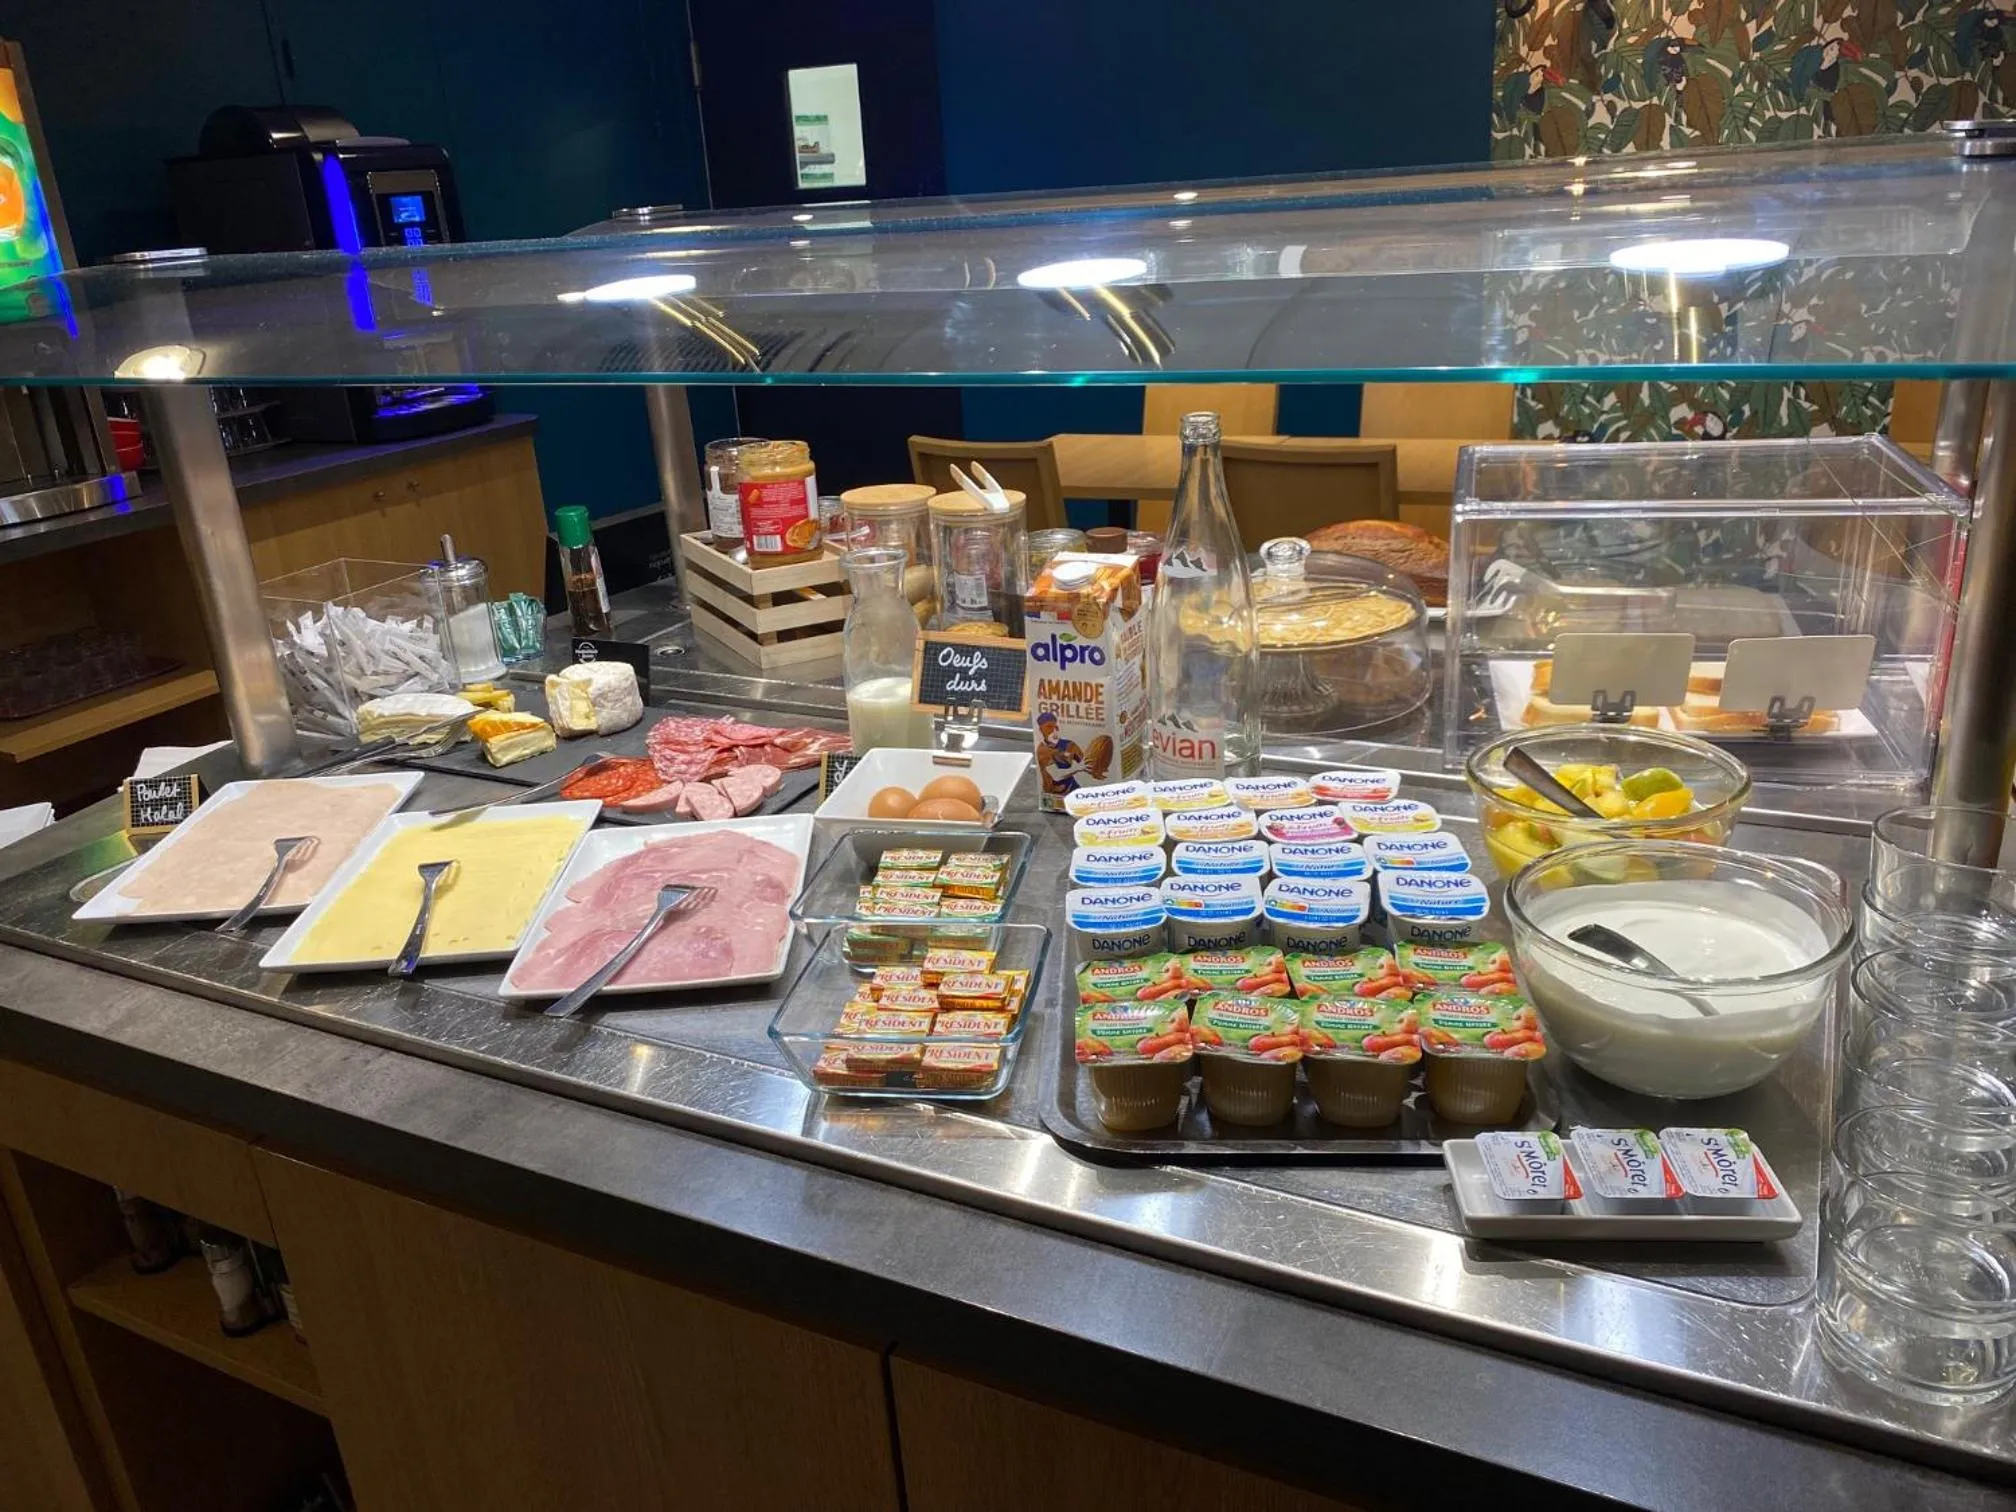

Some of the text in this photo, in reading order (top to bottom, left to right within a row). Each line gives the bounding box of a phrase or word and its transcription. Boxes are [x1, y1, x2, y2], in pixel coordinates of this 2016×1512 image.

[1030, 632, 1106, 670] alpro
[1037, 678, 1105, 705] AMANDE
[1038, 701, 1105, 722] GRILLÉE
[1152, 728, 1217, 761] evian
[136, 782, 181, 802] Poulet
[140, 802, 184, 823] Halal
[1086, 814, 1150, 826] DANONE
[1281, 846, 1352, 856] DANONE
[1376, 840, 1448, 852] DANONE
[1170, 882, 1243, 893] DANONE
[1396, 877, 1472, 889] DANONE
[1278, 883, 1354, 898] DANONE
[1081, 893, 1152, 906] DANONE
[1411, 925, 1472, 941] DANONE
[1092, 934, 1151, 951] DANONE
[1415, 948, 1467, 959] ANDROS
[1092, 965, 1142, 976] ANDROS
[1213, 1001, 1269, 1016] ANDROS
[1318, 1003, 1374, 1016] ANDROS
[1434, 1002, 1489, 1014] ANDROS
